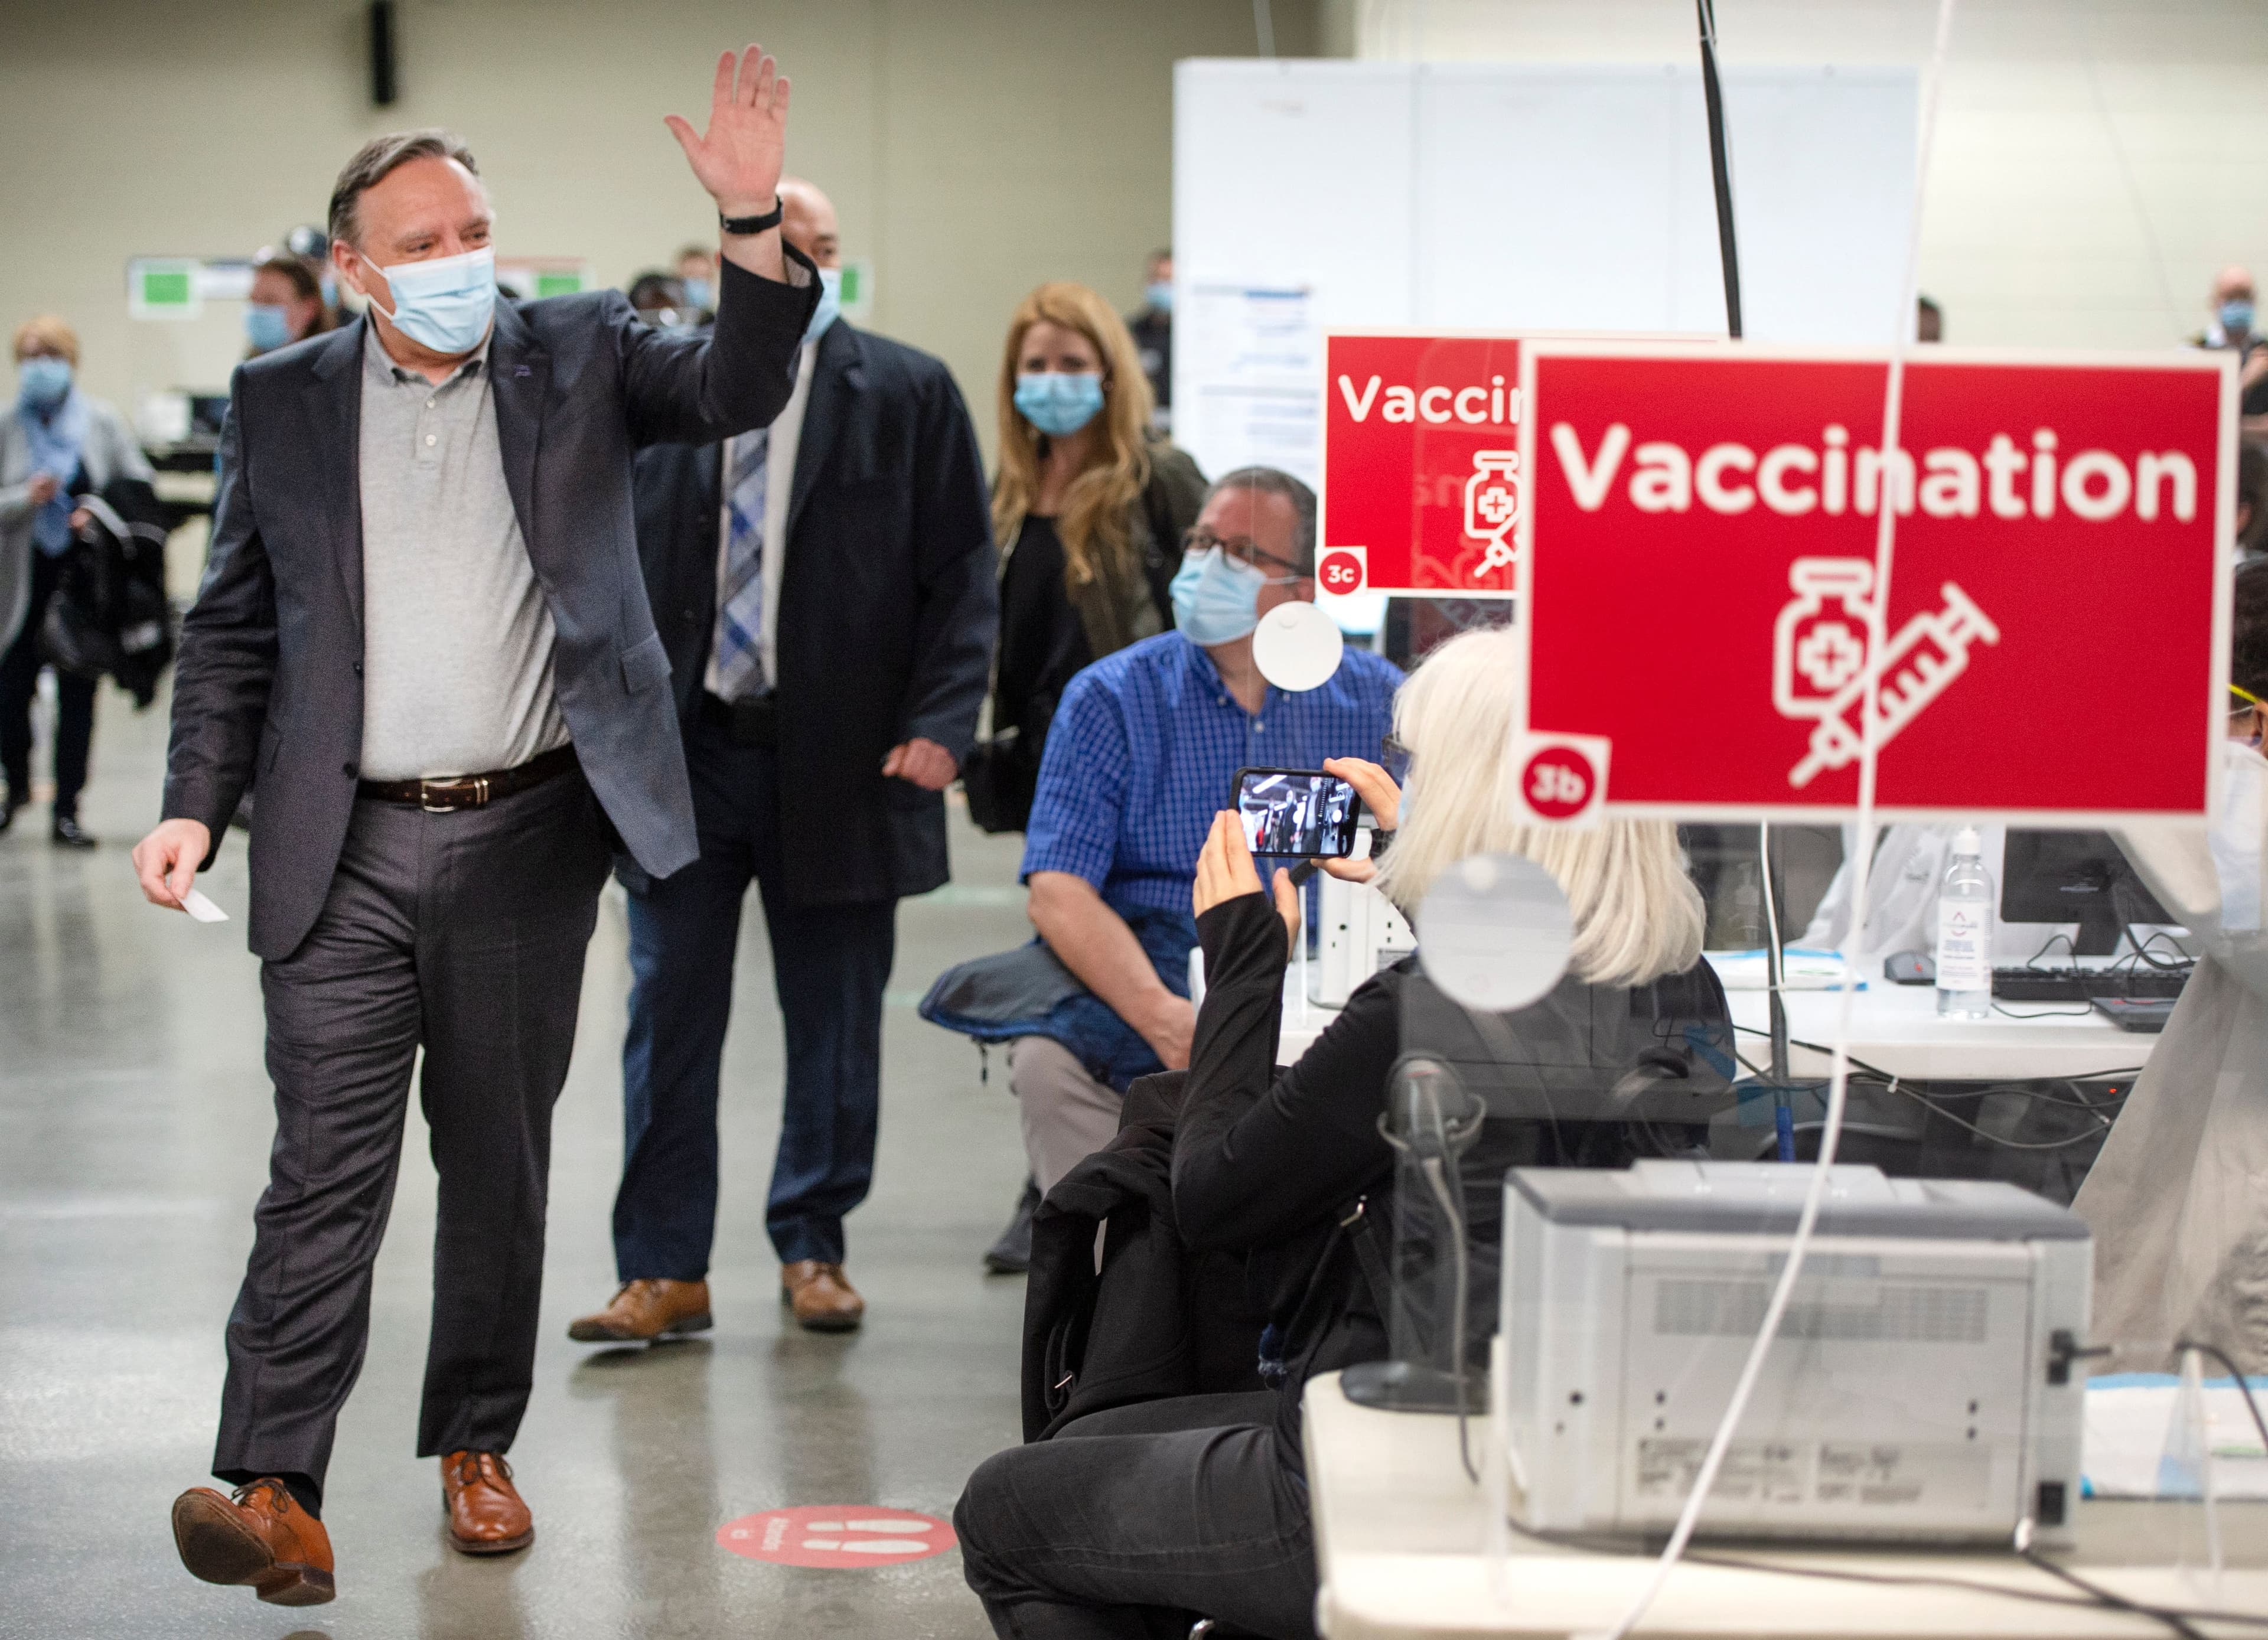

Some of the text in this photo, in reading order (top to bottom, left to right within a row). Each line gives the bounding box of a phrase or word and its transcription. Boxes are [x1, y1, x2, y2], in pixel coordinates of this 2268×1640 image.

[1550, 422, 2198, 523] Vaccination
[1327, 564, 1355, 584] 3c
[1530, 762, 1587, 805] 3b
